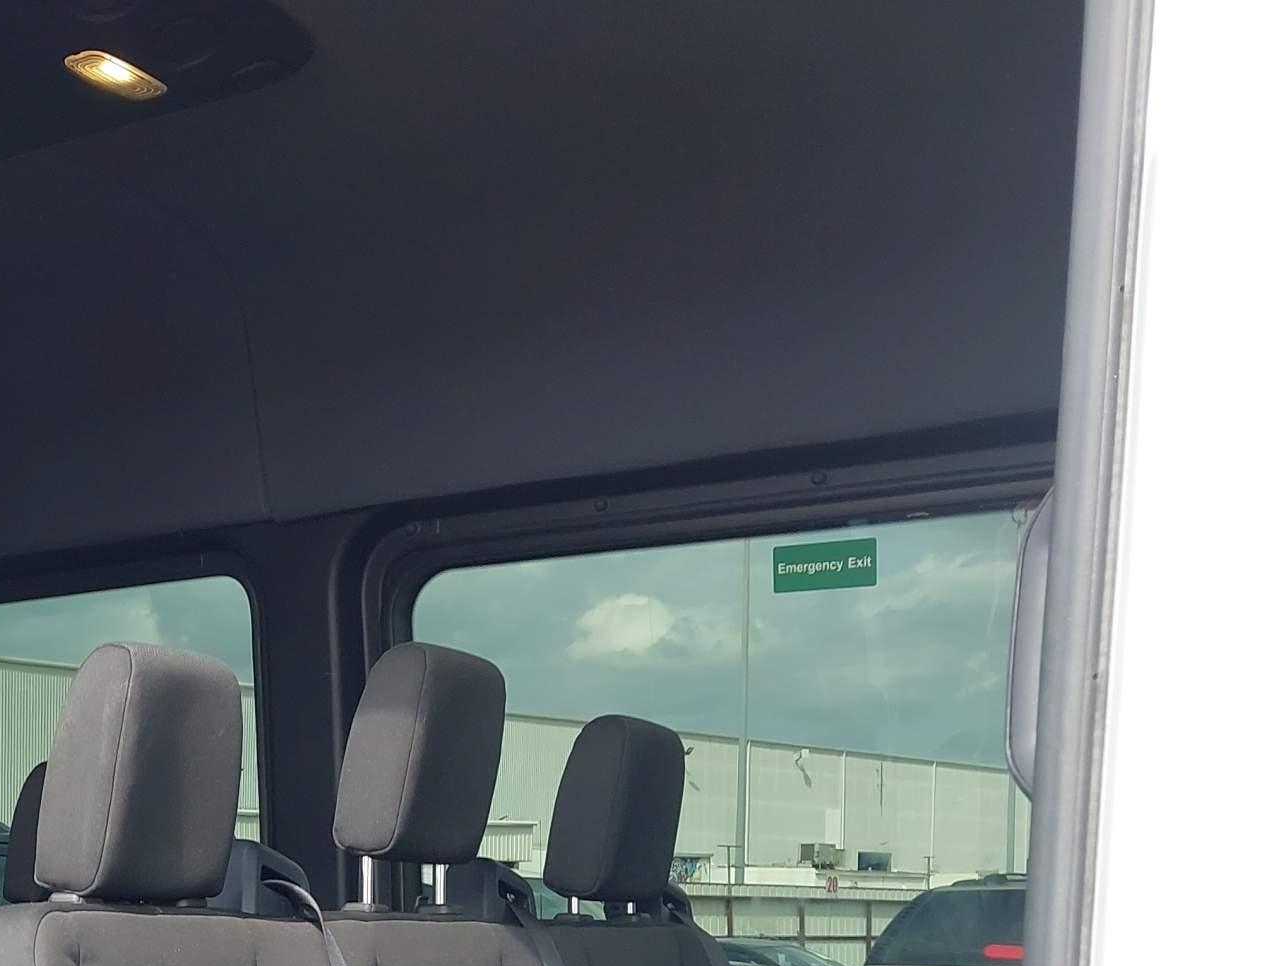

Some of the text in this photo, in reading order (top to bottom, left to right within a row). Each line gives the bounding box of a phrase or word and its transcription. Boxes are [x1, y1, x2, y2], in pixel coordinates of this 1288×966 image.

[777, 555, 872, 575] Emergency Exit
[827, 876, 838, 893] 20
